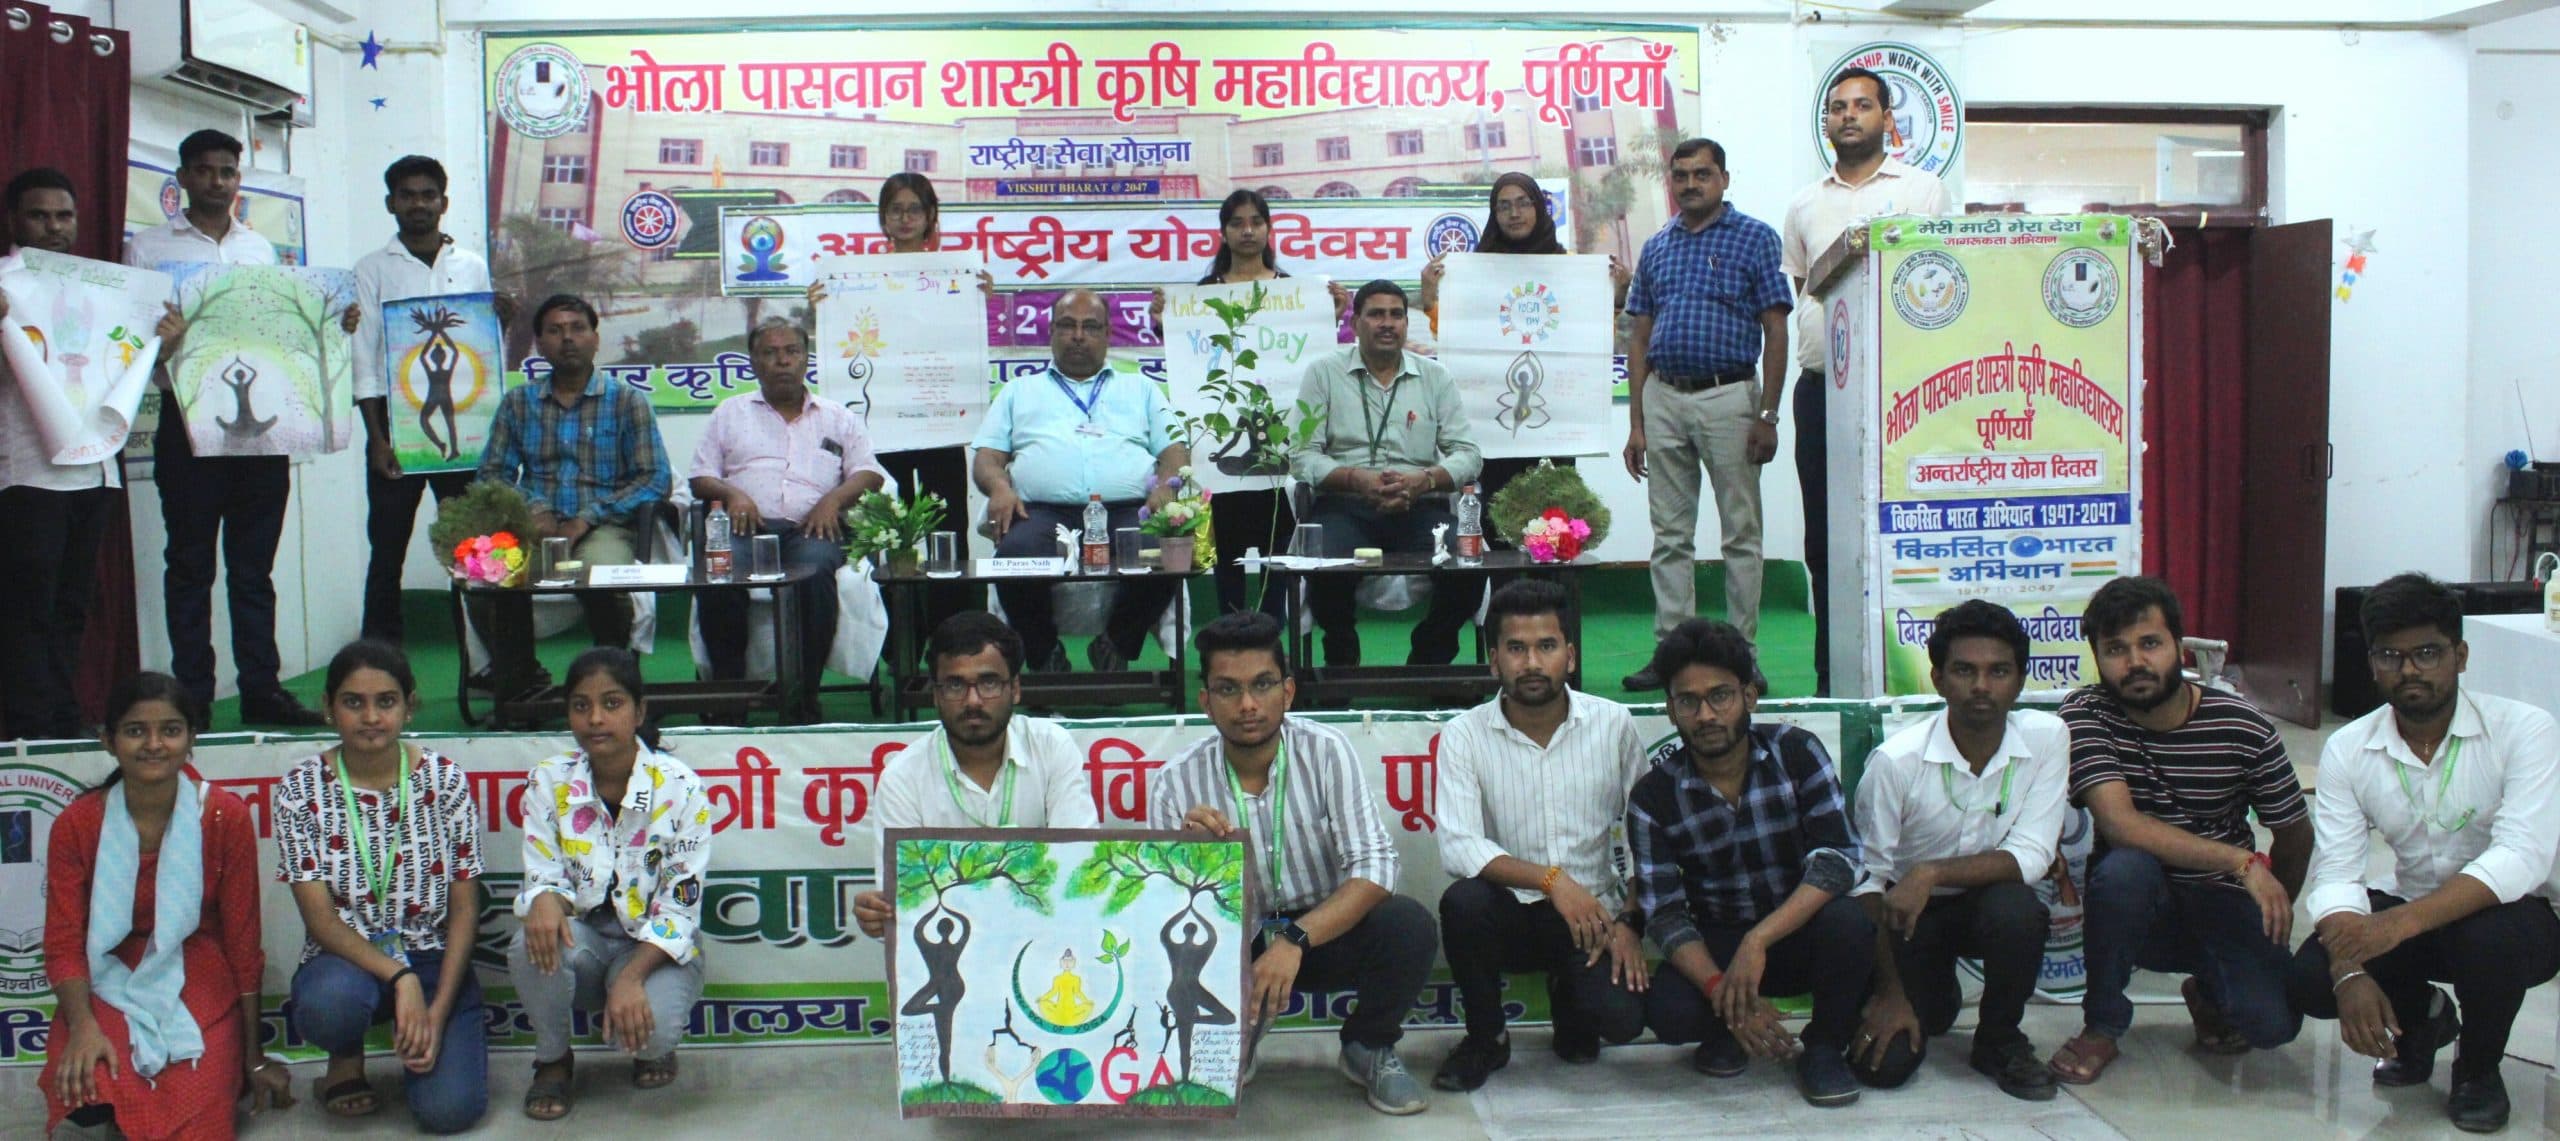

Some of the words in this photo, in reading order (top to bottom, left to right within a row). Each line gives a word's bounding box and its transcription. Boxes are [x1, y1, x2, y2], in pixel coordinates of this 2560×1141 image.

[605, 50, 725, 113] भोला
[738, 60, 926, 110] पासवान
[939, 42, 1084, 110] शास्त्री
[1095, 41, 1200, 122] कृषि
[1212, 41, 1505, 113] महाविद्यालय,
[1522, 41, 1674, 129] पूर्णियाँ
[1888, 51, 1921, 73] WORK
[1920, 66, 1945, 96] WITH
[1937, 95, 1956, 132] SMILE
[969, 138, 1046, 170] राष्ट्रीय
[1052, 137, 1104, 165] सेवा
[1110, 136, 1192, 164] योजना
[1006, 183, 1056, 194] VIKSHIT
[1059, 182, 1109, 194] BHARAT
[1124, 182, 1148, 193] 2047
[1917, 219, 1953, 235] मेरी
[1959, 218, 2001, 234] माटी
[2007, 218, 2043, 233] मेरा
[2049, 218, 2083, 233] देश
[2009, 234, 2058, 246] अभियान
[1257, 325, 1309, 365] Day
[1886, 385, 1920, 446] भोला
[1922, 360, 1974, 416] पासवान
[1976, 341, 2015, 395] शास्त्री
[2017, 343, 2047, 407] कृषि
[2049, 358, 2124, 445] महाविद्यालय
[1976, 407, 2036, 451] पूर्णियाँ
[1915, 456, 2007, 486] अन्तर्राष्ट्रीय
[2011, 457, 2046, 479] योग
[2051, 454, 2098, 478] दिवस
[1890, 504, 1943, 532] विकसित
[1982, 501, 2035, 528] अभियान
[2039, 501, 2118, 527] 1947-2047
[1892, 536, 2008, 561] विकसित
[2042, 536, 2118, 554] भारत
[1948, 559, 2065, 583] अभियान
[18, 775, 76, 801] UNIVER
[413, 798, 428, 837] UNIQUE
[402, 849, 416, 893] ENLIVEN
[417, 841, 431, 907] ASTOUNDING
